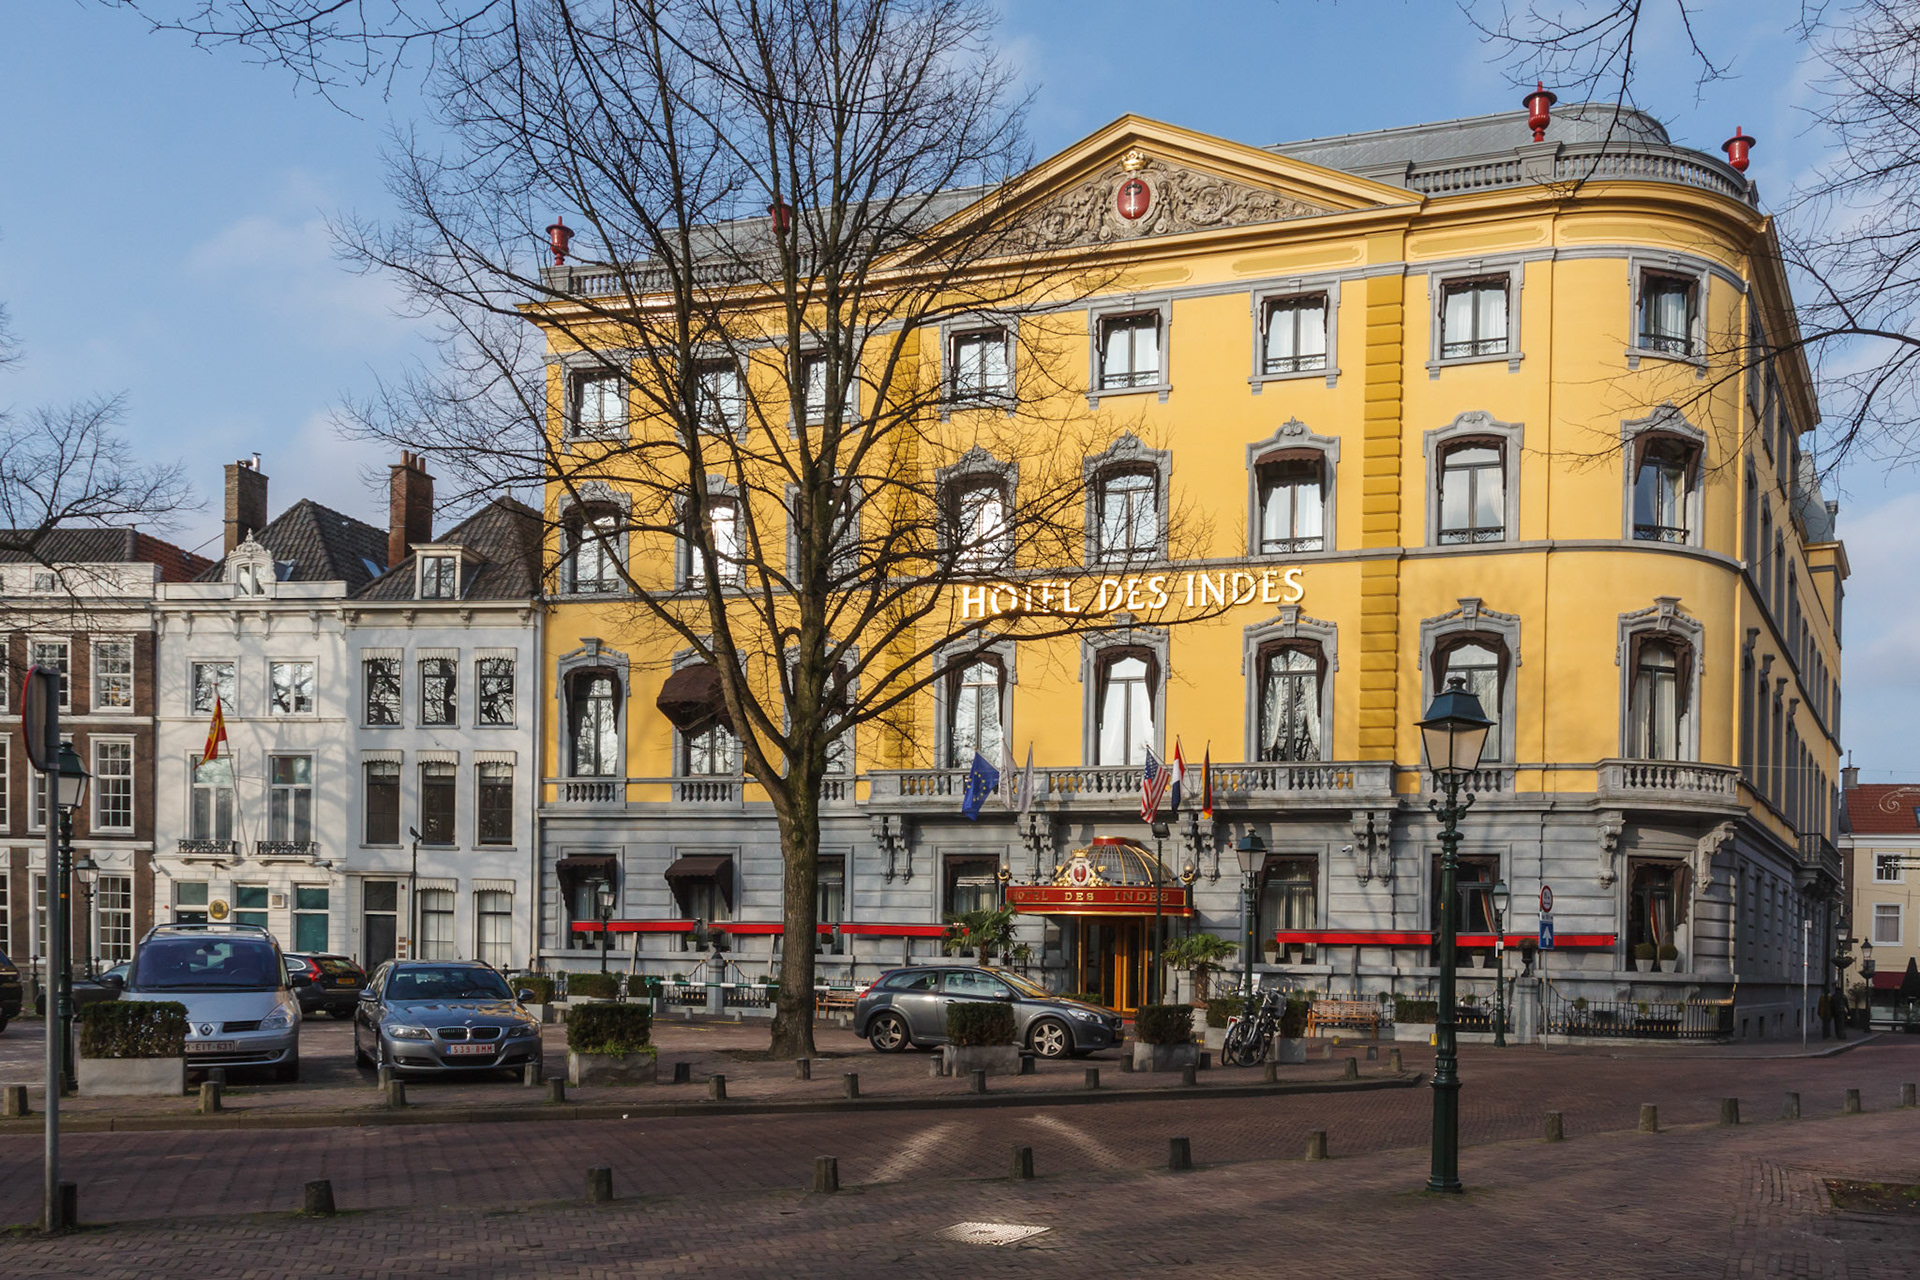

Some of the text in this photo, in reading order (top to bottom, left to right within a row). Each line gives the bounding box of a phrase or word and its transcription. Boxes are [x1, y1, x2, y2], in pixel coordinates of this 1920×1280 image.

[962, 568, 1304, 618] HOTEL DES INDES
[1012, 891, 1169, 902] HOTEL DES INDES
